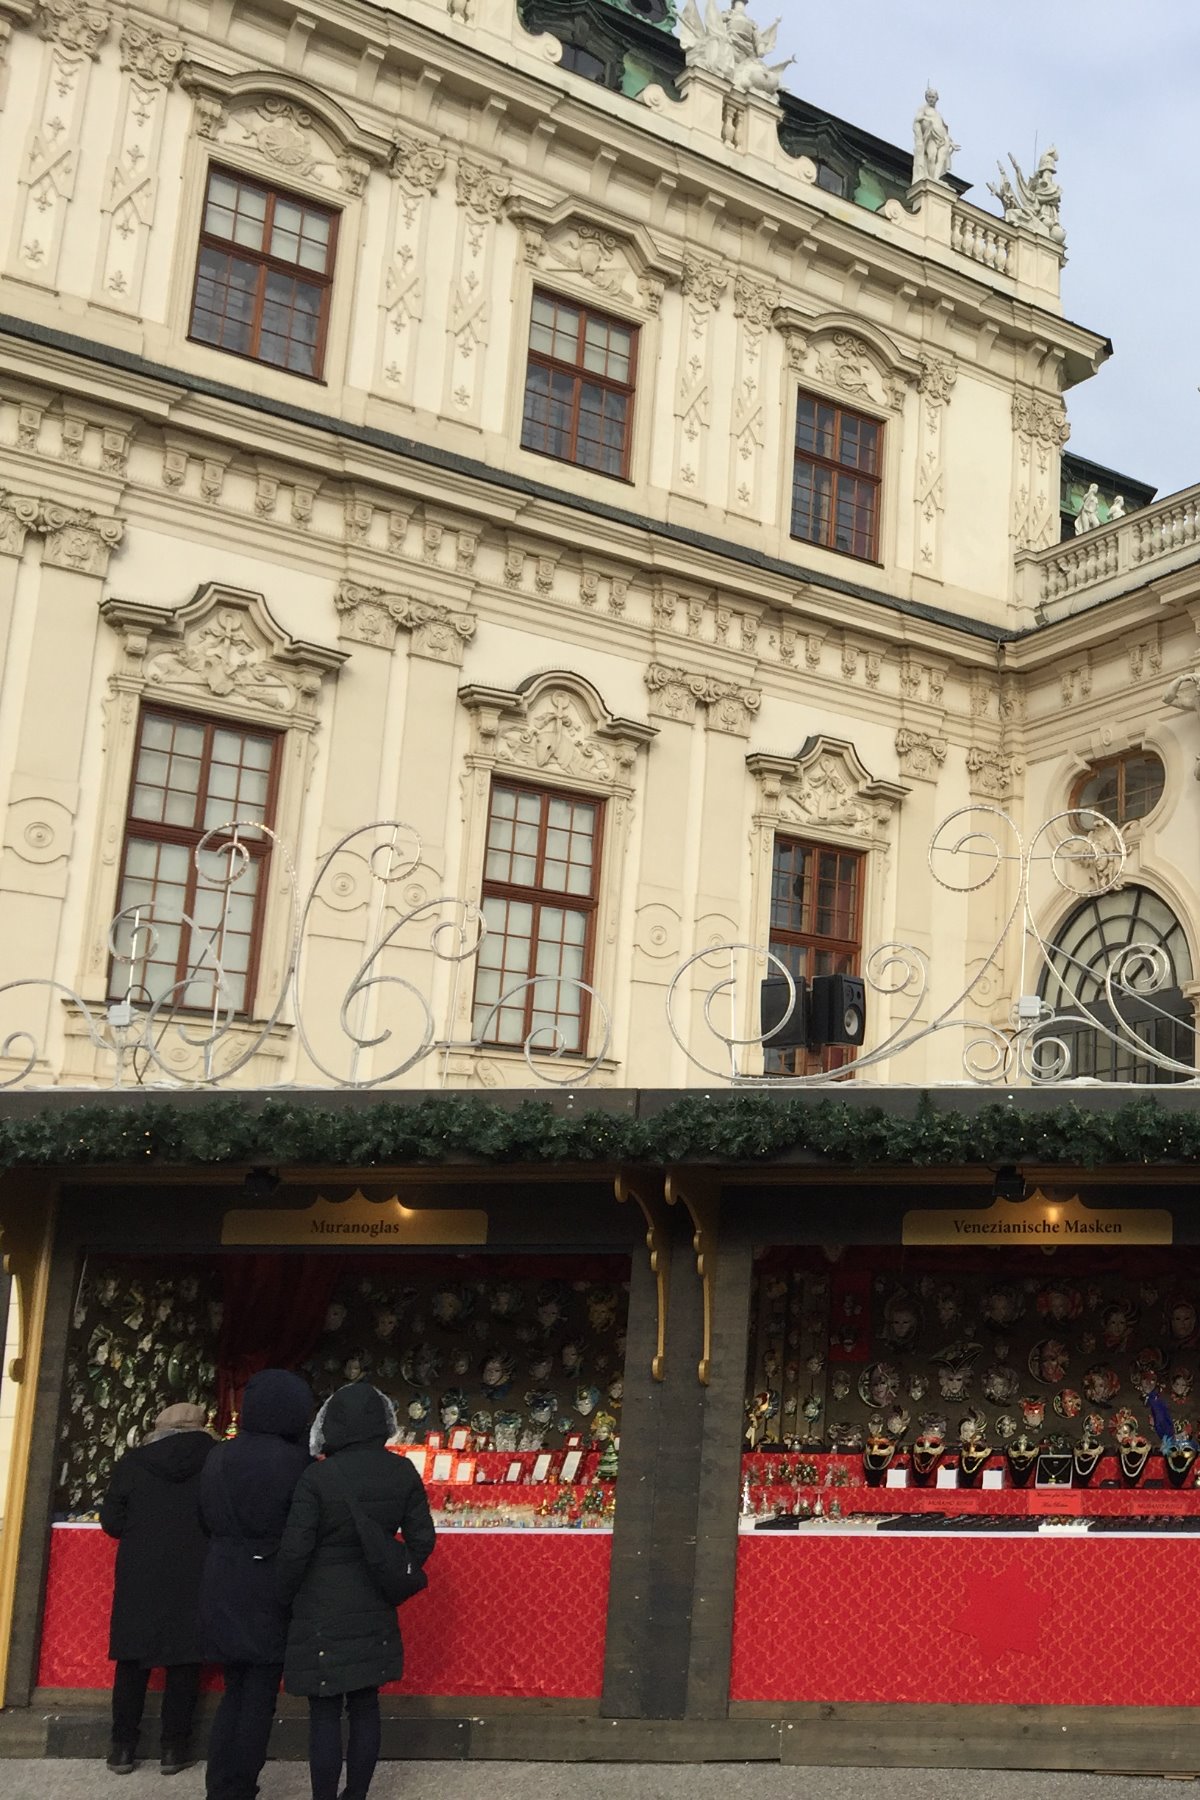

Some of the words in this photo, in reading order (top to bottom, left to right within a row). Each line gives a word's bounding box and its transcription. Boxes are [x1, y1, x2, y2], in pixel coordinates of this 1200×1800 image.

[310, 1219, 400, 1238] Muranoglas
[953, 1219, 1060, 1234] Venezianische
[1064, 1219, 1123, 1234] Masken
